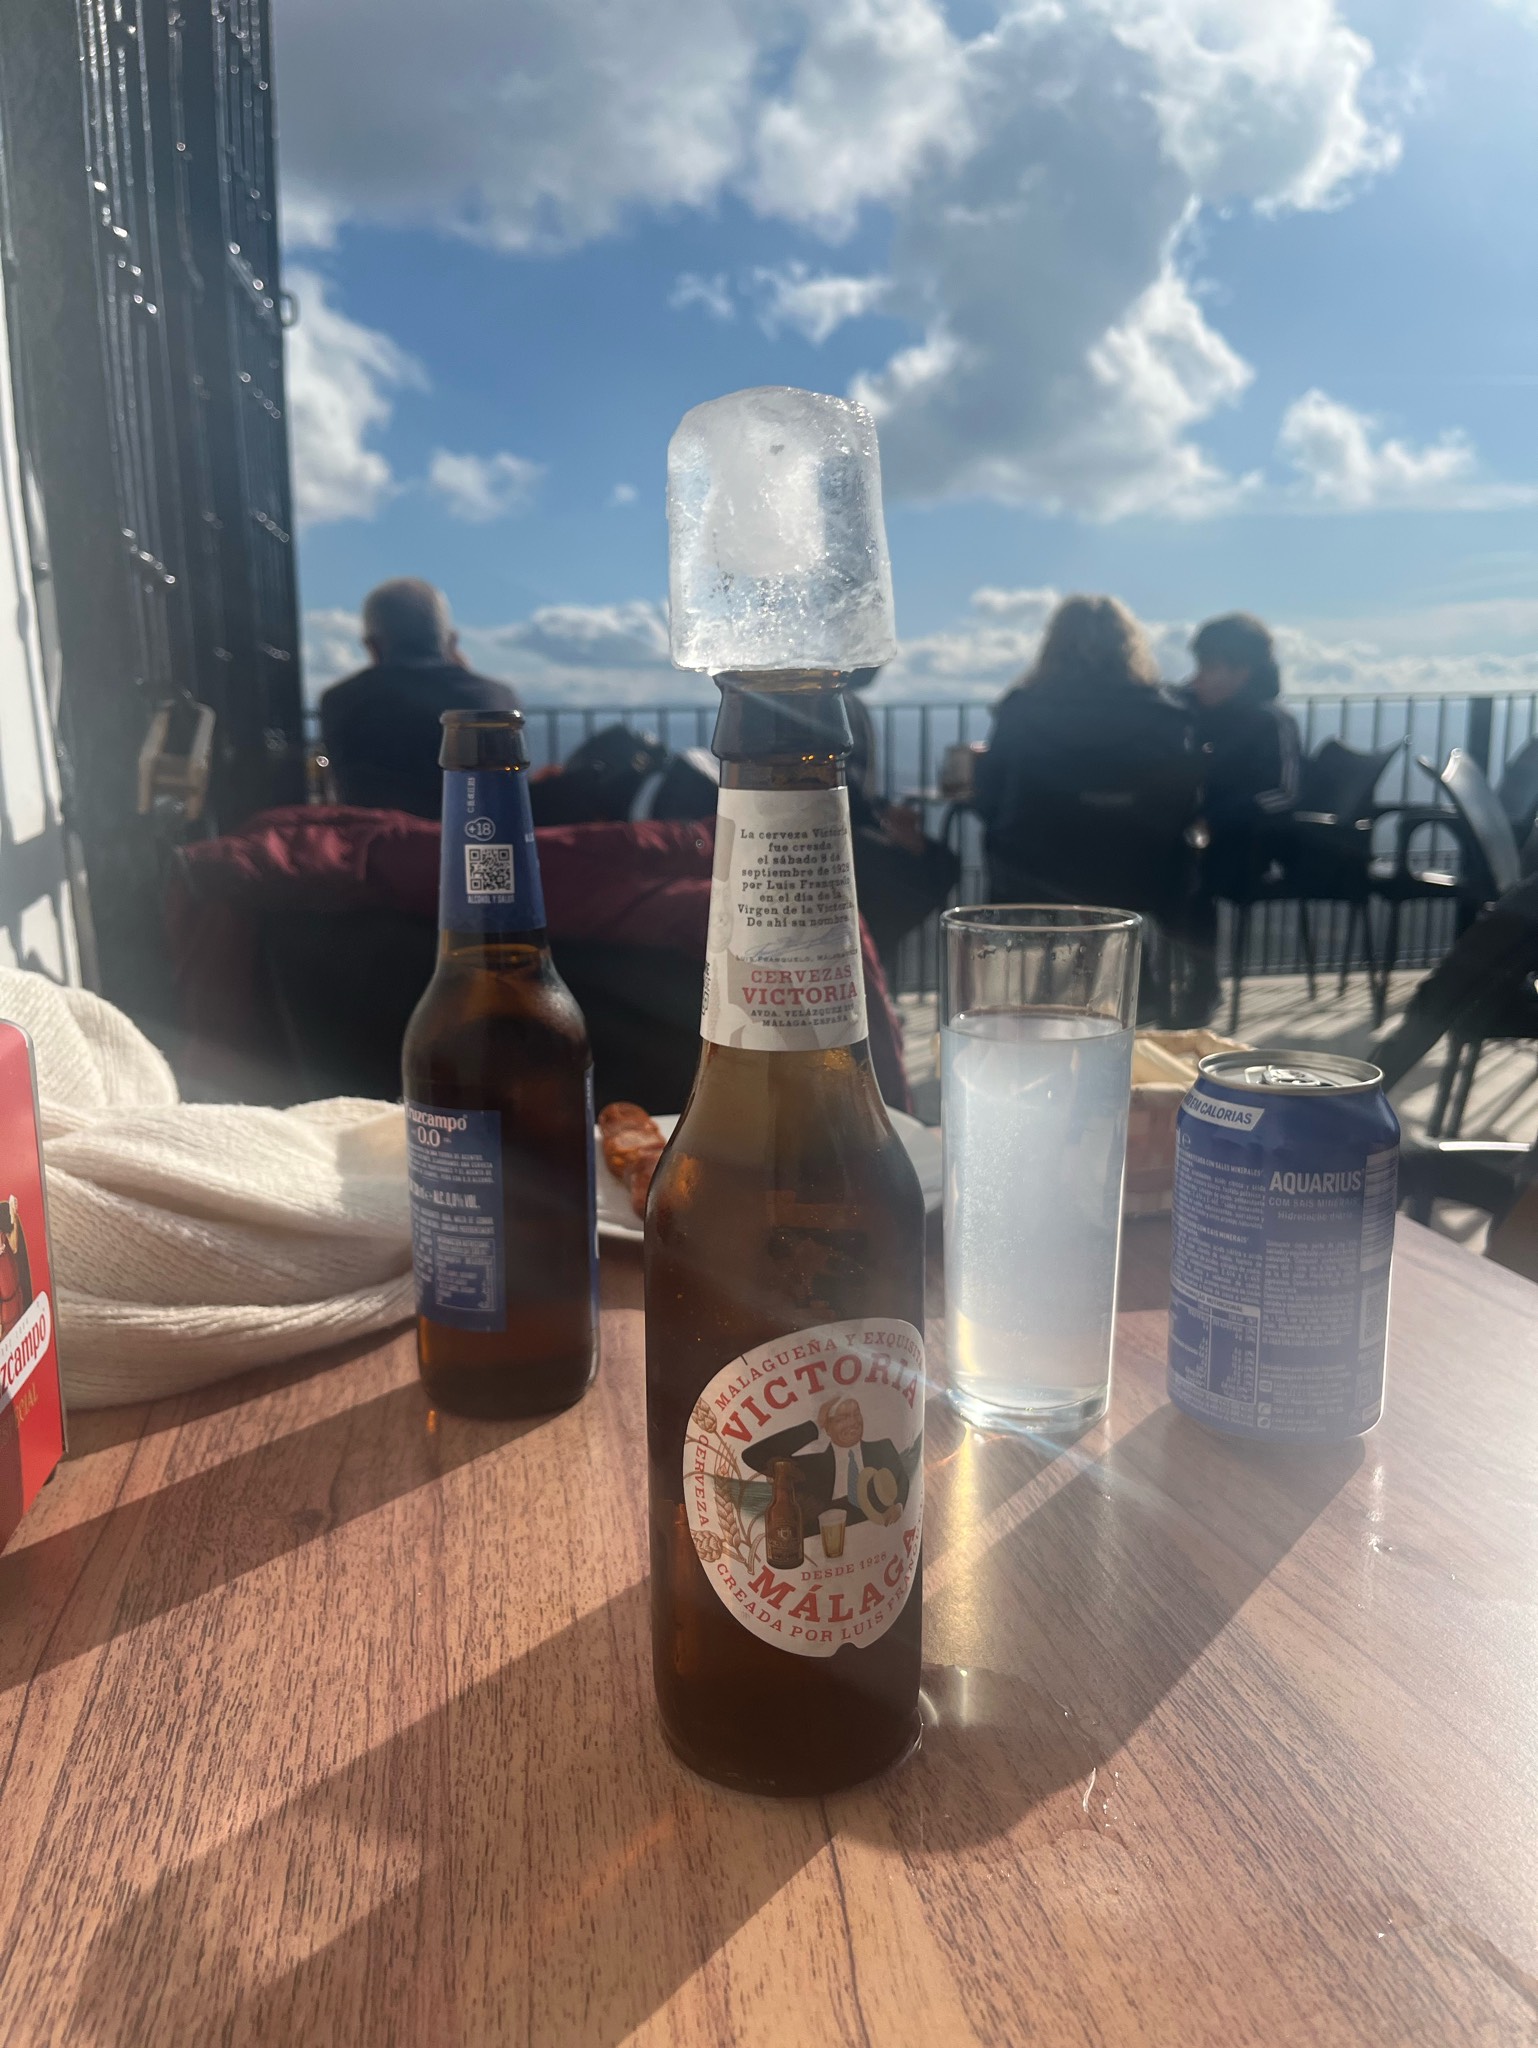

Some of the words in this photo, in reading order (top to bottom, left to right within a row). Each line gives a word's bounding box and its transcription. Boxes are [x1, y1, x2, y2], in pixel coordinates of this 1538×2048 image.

[740, 828, 755, 839] La
[759, 831, 808, 840] cerveza
[768, 842, 789, 852] fue
[792, 841, 832, 852] creada
[757, 855, 768, 864] el
[773, 855, 817, 864] sábado
[741, 868, 814, 879] septiembre
[817, 867, 830, 875] de
[742, 881, 762, 891] por
[767, 880, 796, 890] Luis
[759, 894, 774, 902] en
[778, 893, 789, 902] el
[794, 892, 813, 902] día
[817, 892, 830, 901] de
[738, 904, 778, 917] Virgen
[782, 905, 798, 914] de
[802, 904, 813, 914] la
[746, 917, 762, 927] De
[767, 917, 787, 927] ahí
[791, 919, 806, 927] su
[751, 965, 852, 984] CERVEZAS
[742, 982, 858, 1006] VICTORIA
[1200, 1102, 1253, 1125] CALORIAS
[1269, 1171, 1361, 1195] AQUARIUS
[1269, 1197, 1290, 1207] COM
[0, 1313, 46, 1397] zcampo
[715, 1338, 838, 1411] MALAGUEÑA
[845, 1333, 857, 1347] Y
[721, 1353, 921, 1443] VICTORIA
[695, 1435, 709, 1527] CERVEZA
[748, 1527, 917, 1624] MÁLAGA
[801, 1564, 855, 1582] DESDE
[859, 1551, 888, 1571] 1928
[717, 1563, 783, 1633] CREADA
[790, 1626, 833, 1643] POR
[840, 1611, 884, 1641] LUIS
